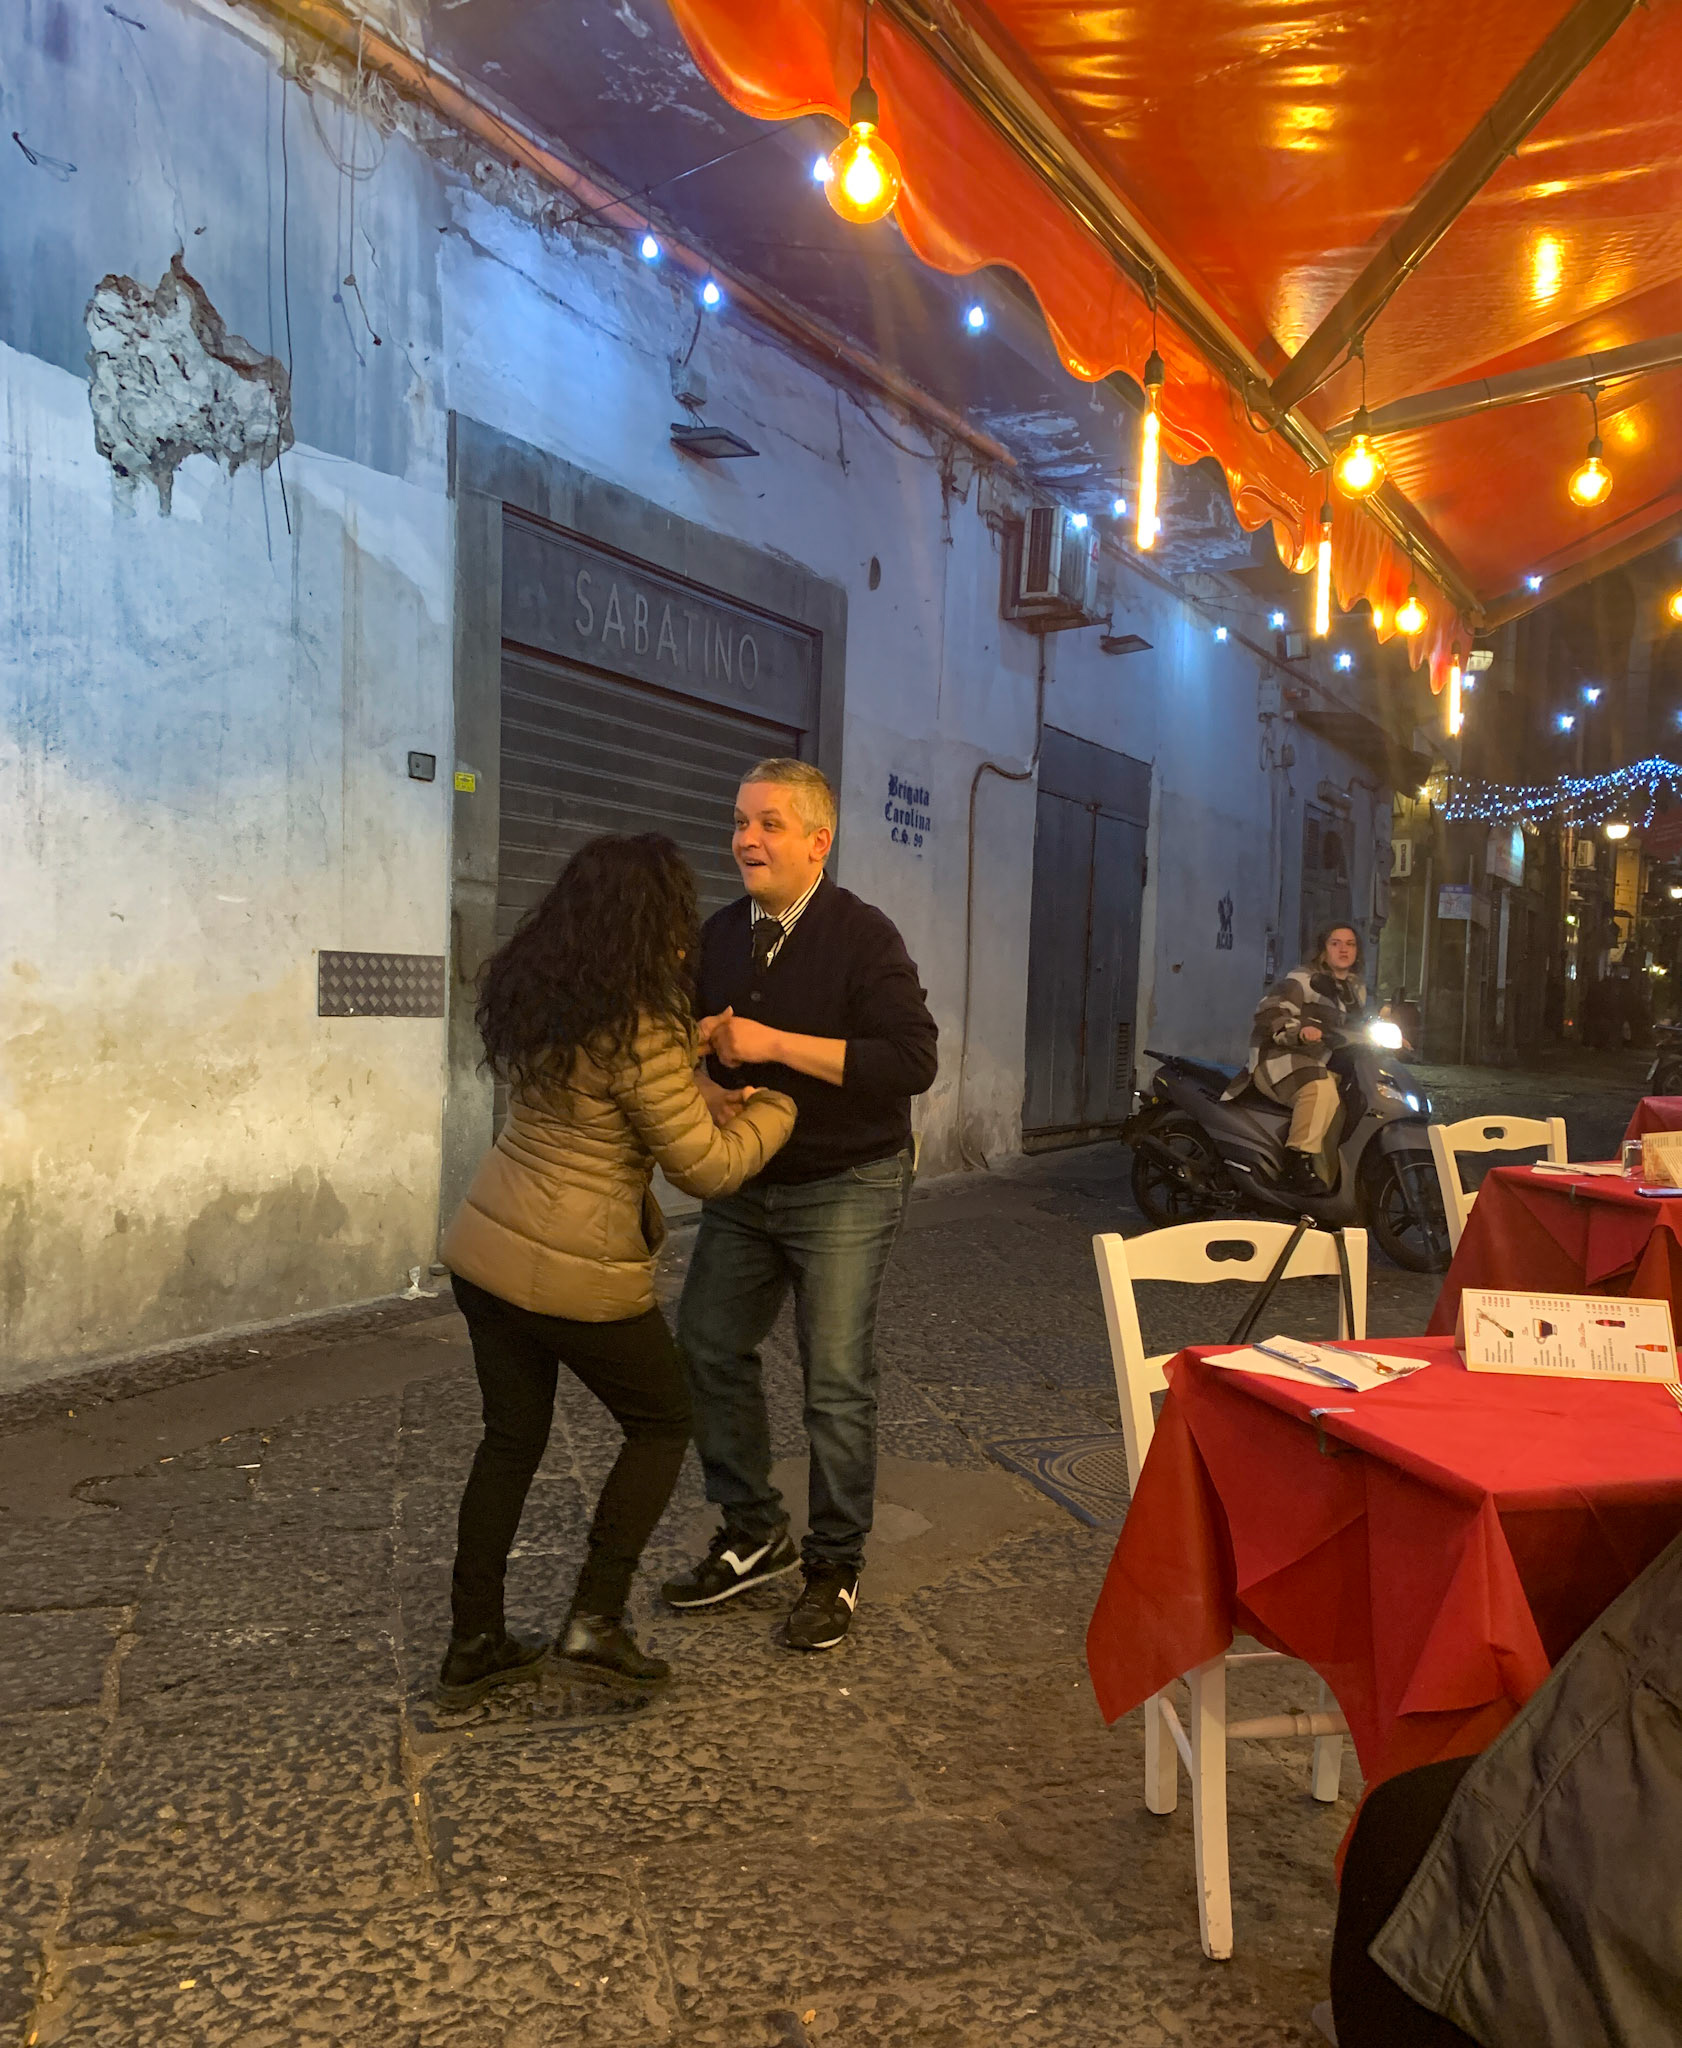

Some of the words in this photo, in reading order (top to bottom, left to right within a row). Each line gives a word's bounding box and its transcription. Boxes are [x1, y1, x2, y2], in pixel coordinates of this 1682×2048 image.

[575, 568, 760, 690] SABATINO
[887, 773, 930, 807] Brigata
[884, 800, 932, 832] Carolina
